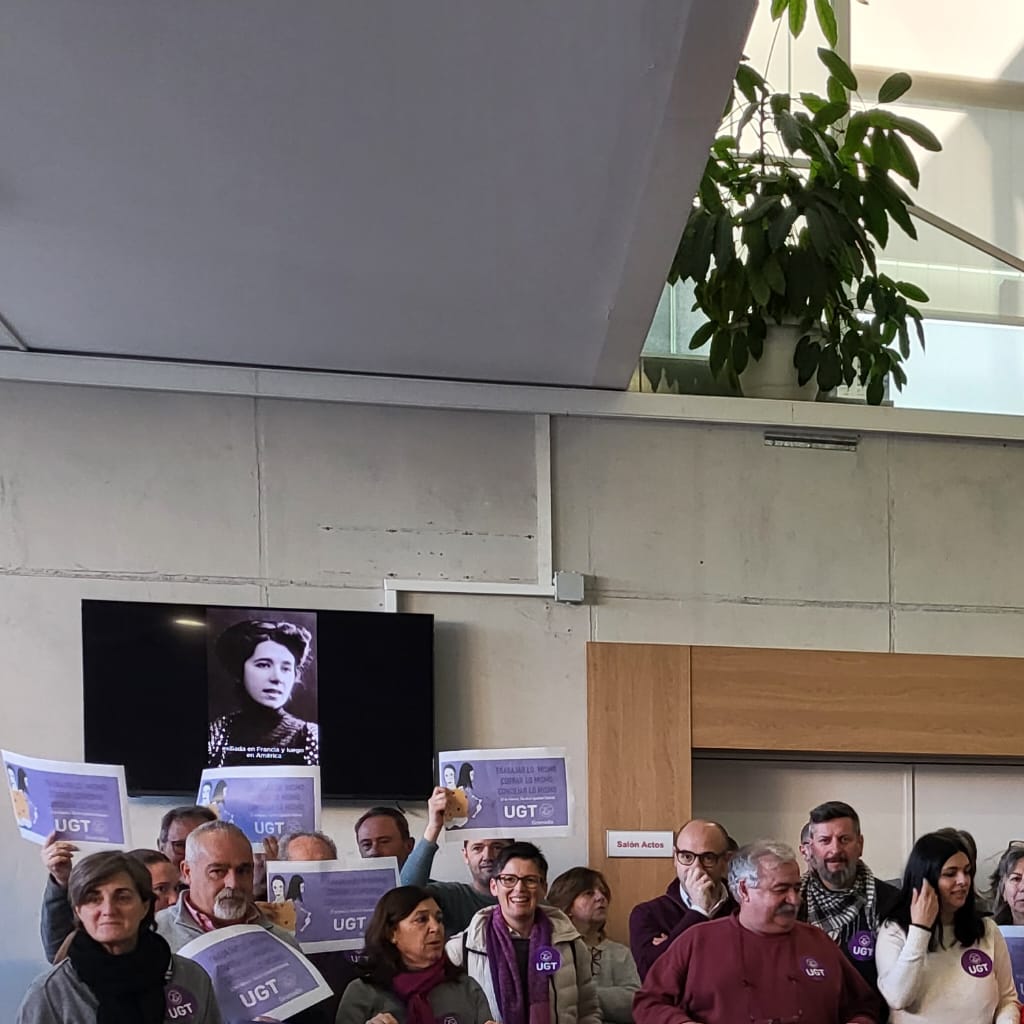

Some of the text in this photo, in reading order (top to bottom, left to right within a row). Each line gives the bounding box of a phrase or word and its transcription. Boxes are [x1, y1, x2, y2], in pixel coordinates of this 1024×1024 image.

[504, 804, 538, 819] UGT
[54, 818, 91, 833] UGT
[254, 821, 285, 834] UGT
[617, 840, 664, 849] Salón Actos
[333, 916, 367, 931] UGT
[852, 945, 873, 957] UGT
[536, 961, 558, 971] UGT
[805, 967, 825, 977] UGT
[967, 962, 989, 975] UGT
[239, 978, 280, 1008] UGT
[168, 1002, 194, 1019] UGT
